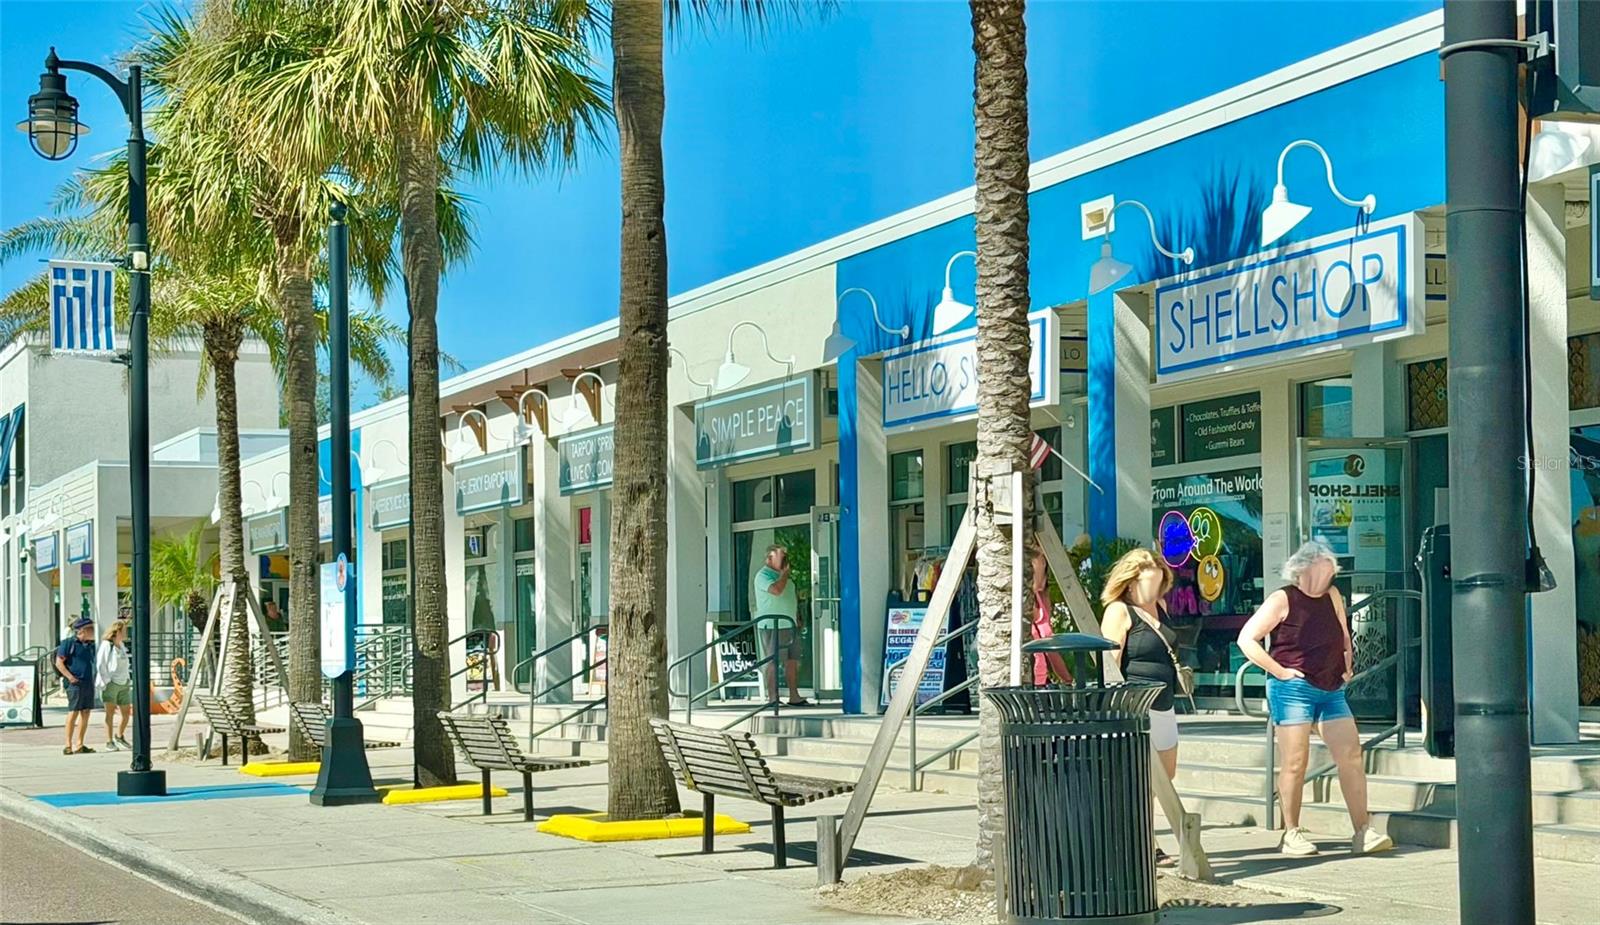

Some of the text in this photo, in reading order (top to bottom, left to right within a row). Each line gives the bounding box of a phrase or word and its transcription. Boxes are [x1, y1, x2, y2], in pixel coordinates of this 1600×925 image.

[1169, 252, 1384, 354] SHELLSHOP
[888, 361, 952, 405] HELLO,
[1219, 405, 1241, 417] Truffles
[1246, 401, 1261, 414] Toffe
[711, 408, 755, 445] SIMPLE
[757, 397, 804, 435] PEACE
[1197, 418, 1256, 437] Old Fashioned Candy
[1208, 437, 1245, 451] Gummi Bears
[1151, 484, 1176, 500] From
[1177, 477, 1214, 498] Around
[1214, 476, 1234, 494] The
[741, 640, 756, 656] OIL
[889, 635, 916, 645] SUGA
